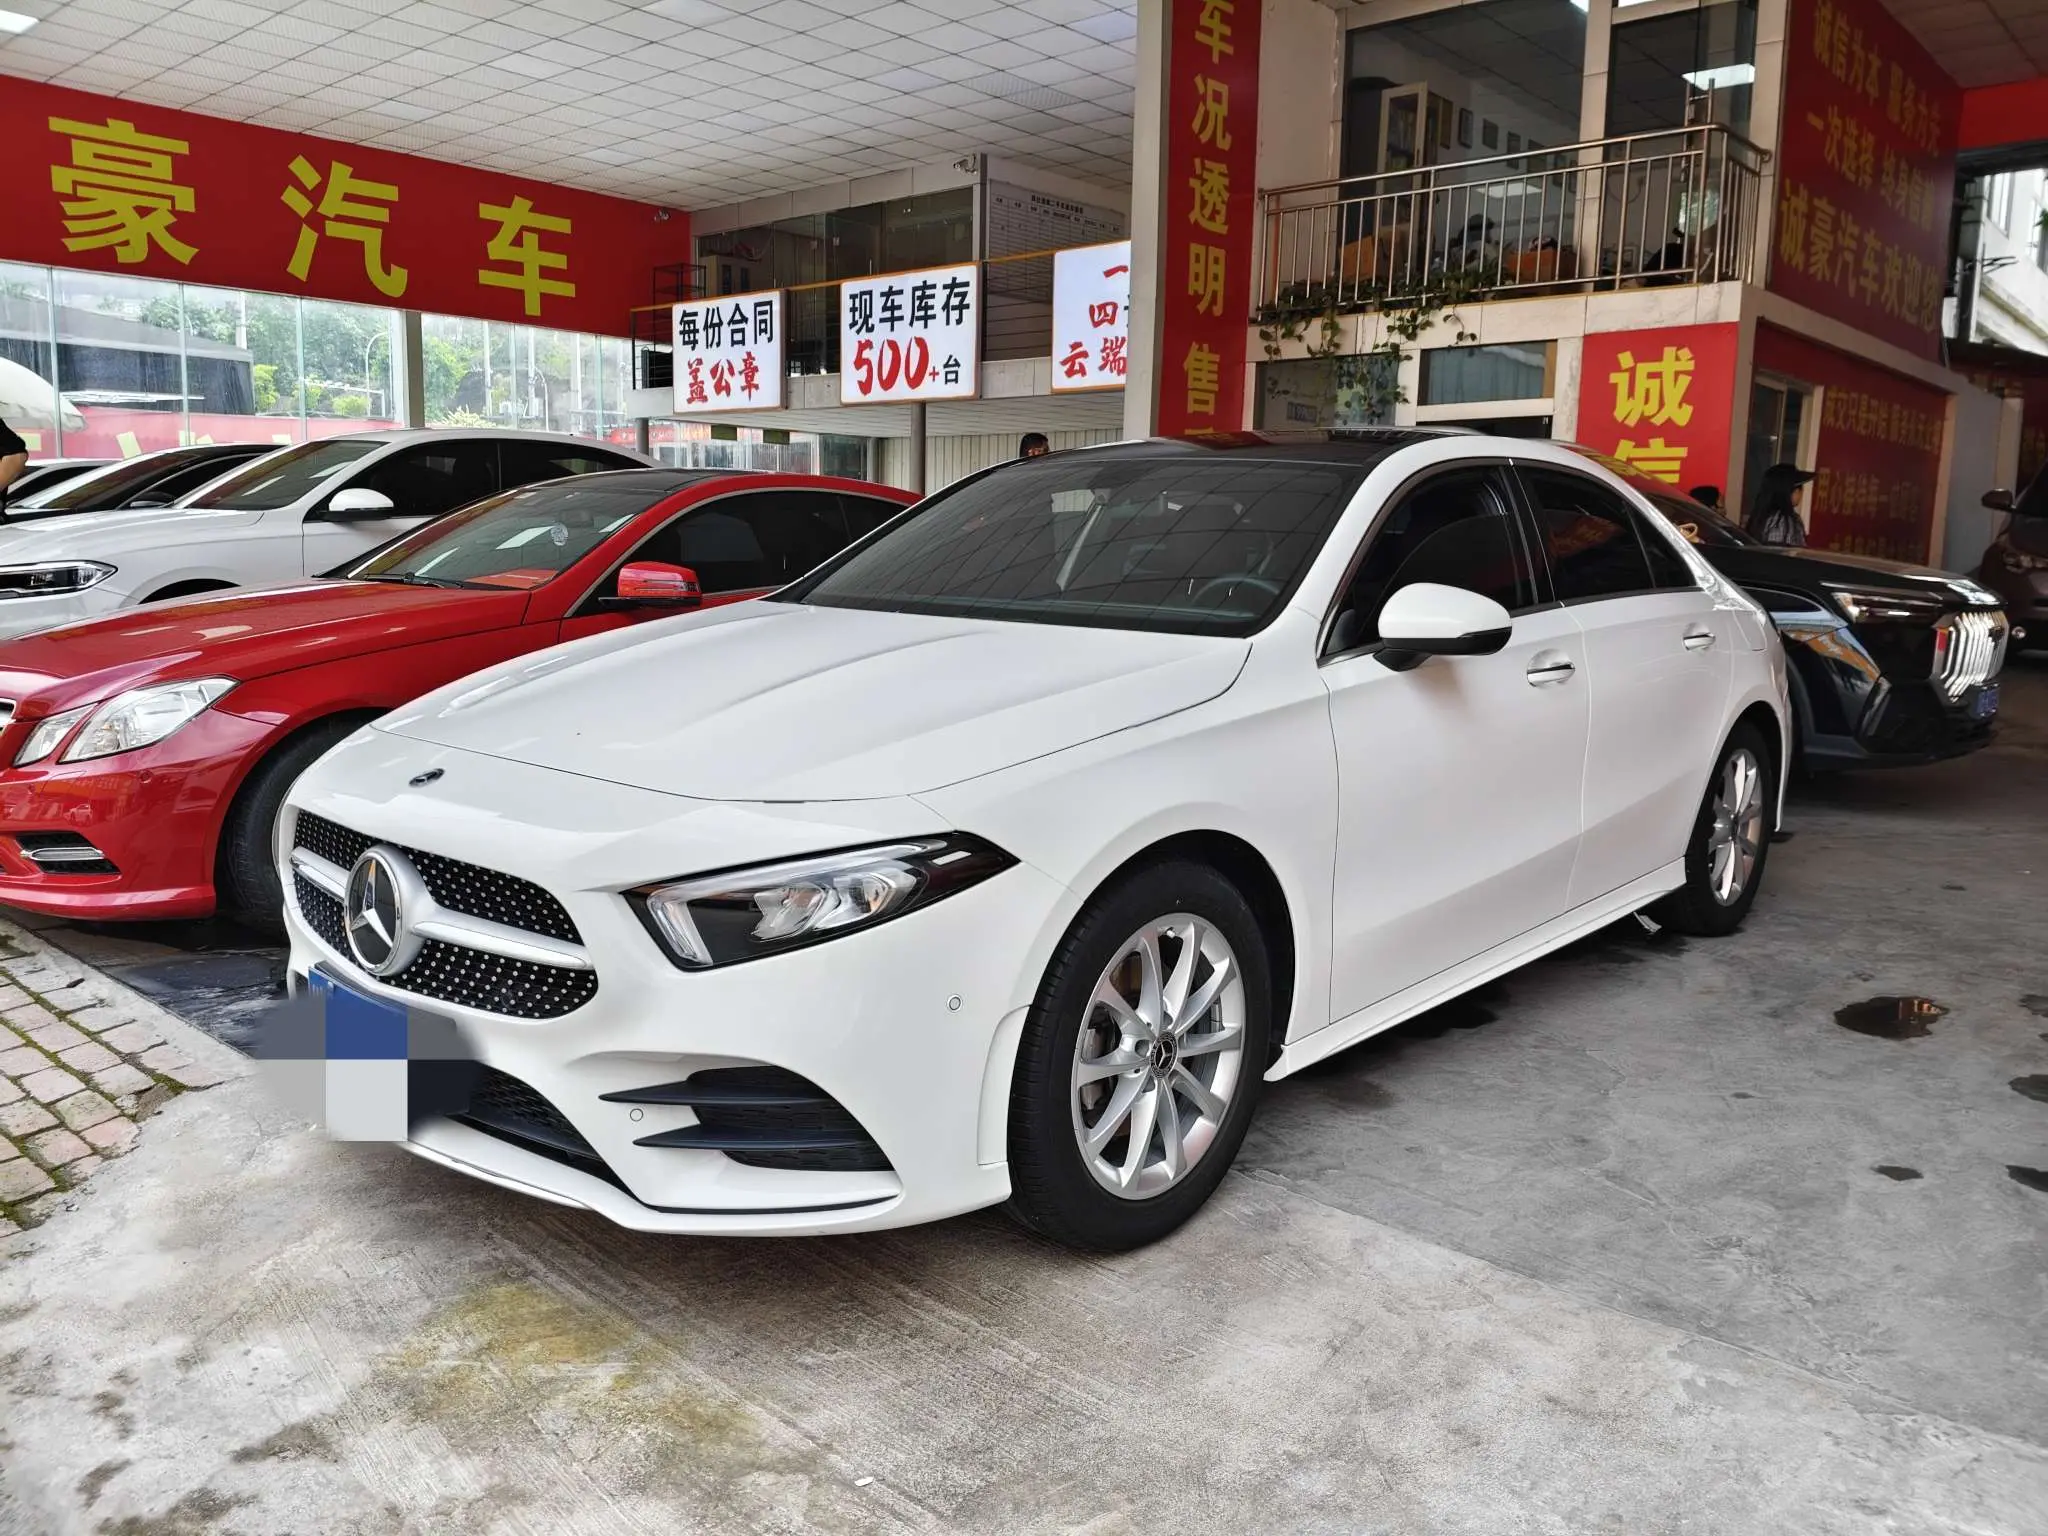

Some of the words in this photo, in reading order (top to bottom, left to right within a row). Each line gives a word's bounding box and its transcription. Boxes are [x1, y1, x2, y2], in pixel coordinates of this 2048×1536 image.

[1187, 0, 1235, 318] 车况透明
[47, 116, 577, 317] 豪汽车
[1780, 176, 1940, 334] 诚豪汽车欢迎您
[679, 300, 774, 351] 每份合同
[849, 276, 971, 336] 现车库存
[686, 351, 760, 405] 盖公章
[1183, 341, 1221, 435] 售
